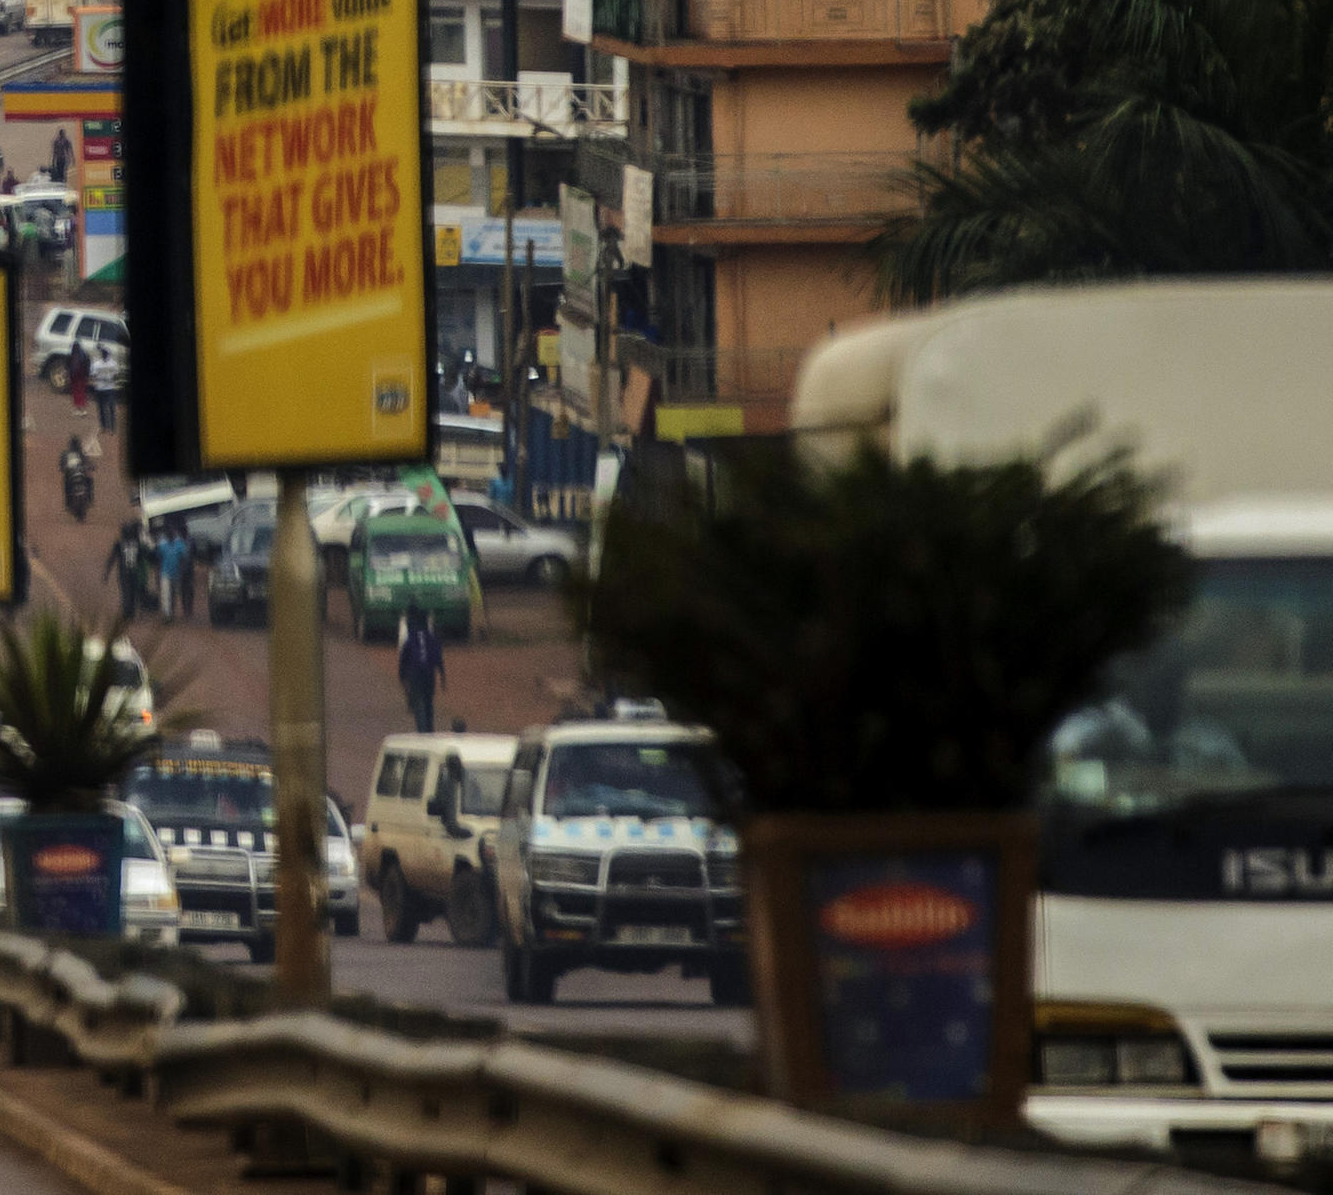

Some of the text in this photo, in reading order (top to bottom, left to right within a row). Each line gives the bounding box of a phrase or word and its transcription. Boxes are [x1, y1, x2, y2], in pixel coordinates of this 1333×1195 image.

[214, 26, 380, 117] FROM THE
[214, 93, 379, 188] NETWORK
[222, 156, 401, 254] THAT GIVES
[227, 225, 405, 324] YOU MORE.
